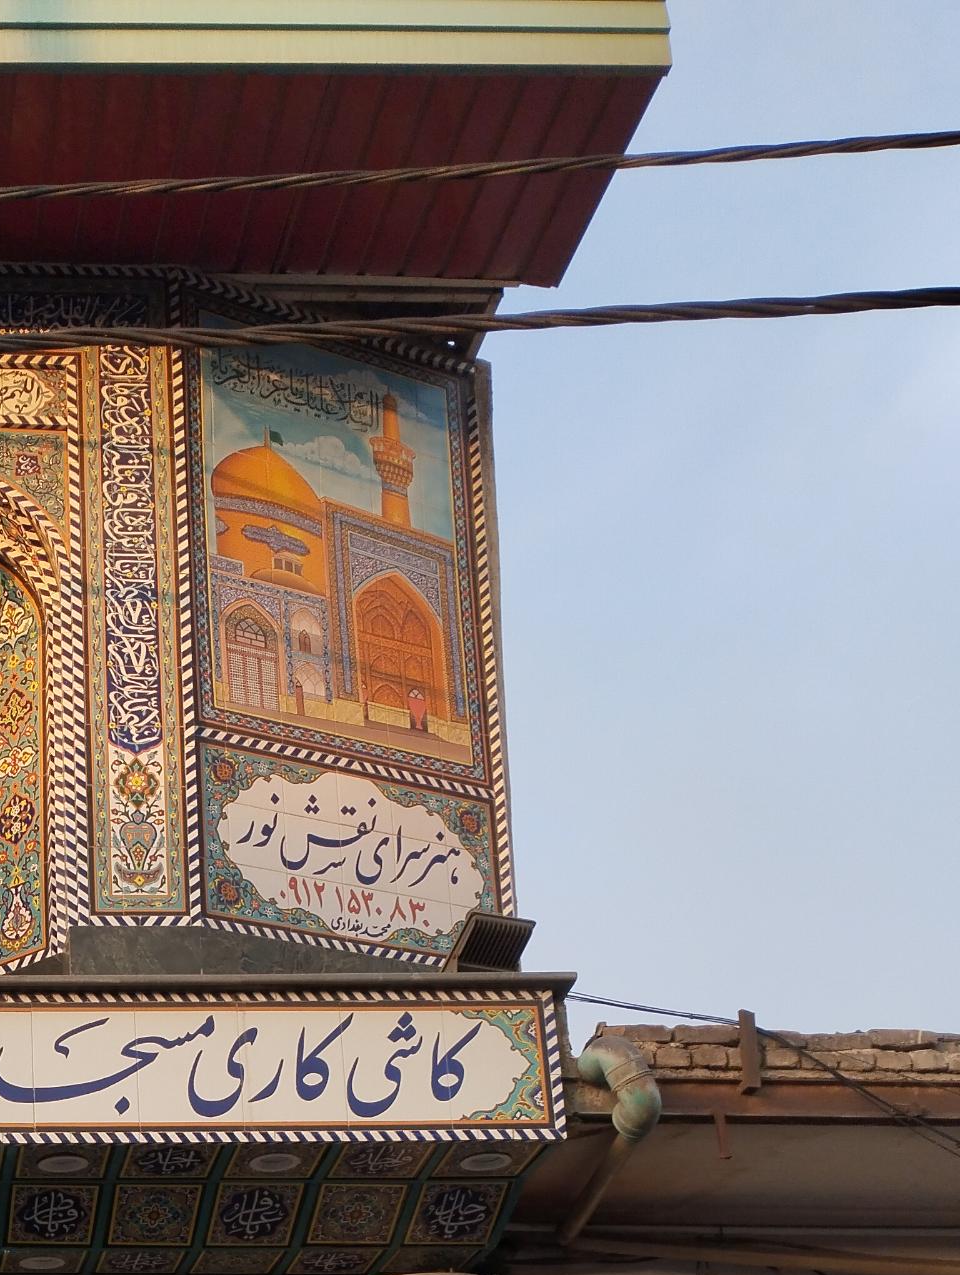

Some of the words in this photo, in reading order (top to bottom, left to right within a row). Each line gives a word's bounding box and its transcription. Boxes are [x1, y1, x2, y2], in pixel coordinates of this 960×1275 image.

[236, 792, 280, 848] نور
[280, 794, 377, 871] نقش
[280, 876, 325, 909] ۰۹۱۲
[188, 1010, 353, 1118] کاری
[347, 1010, 484, 1118] کاشی
